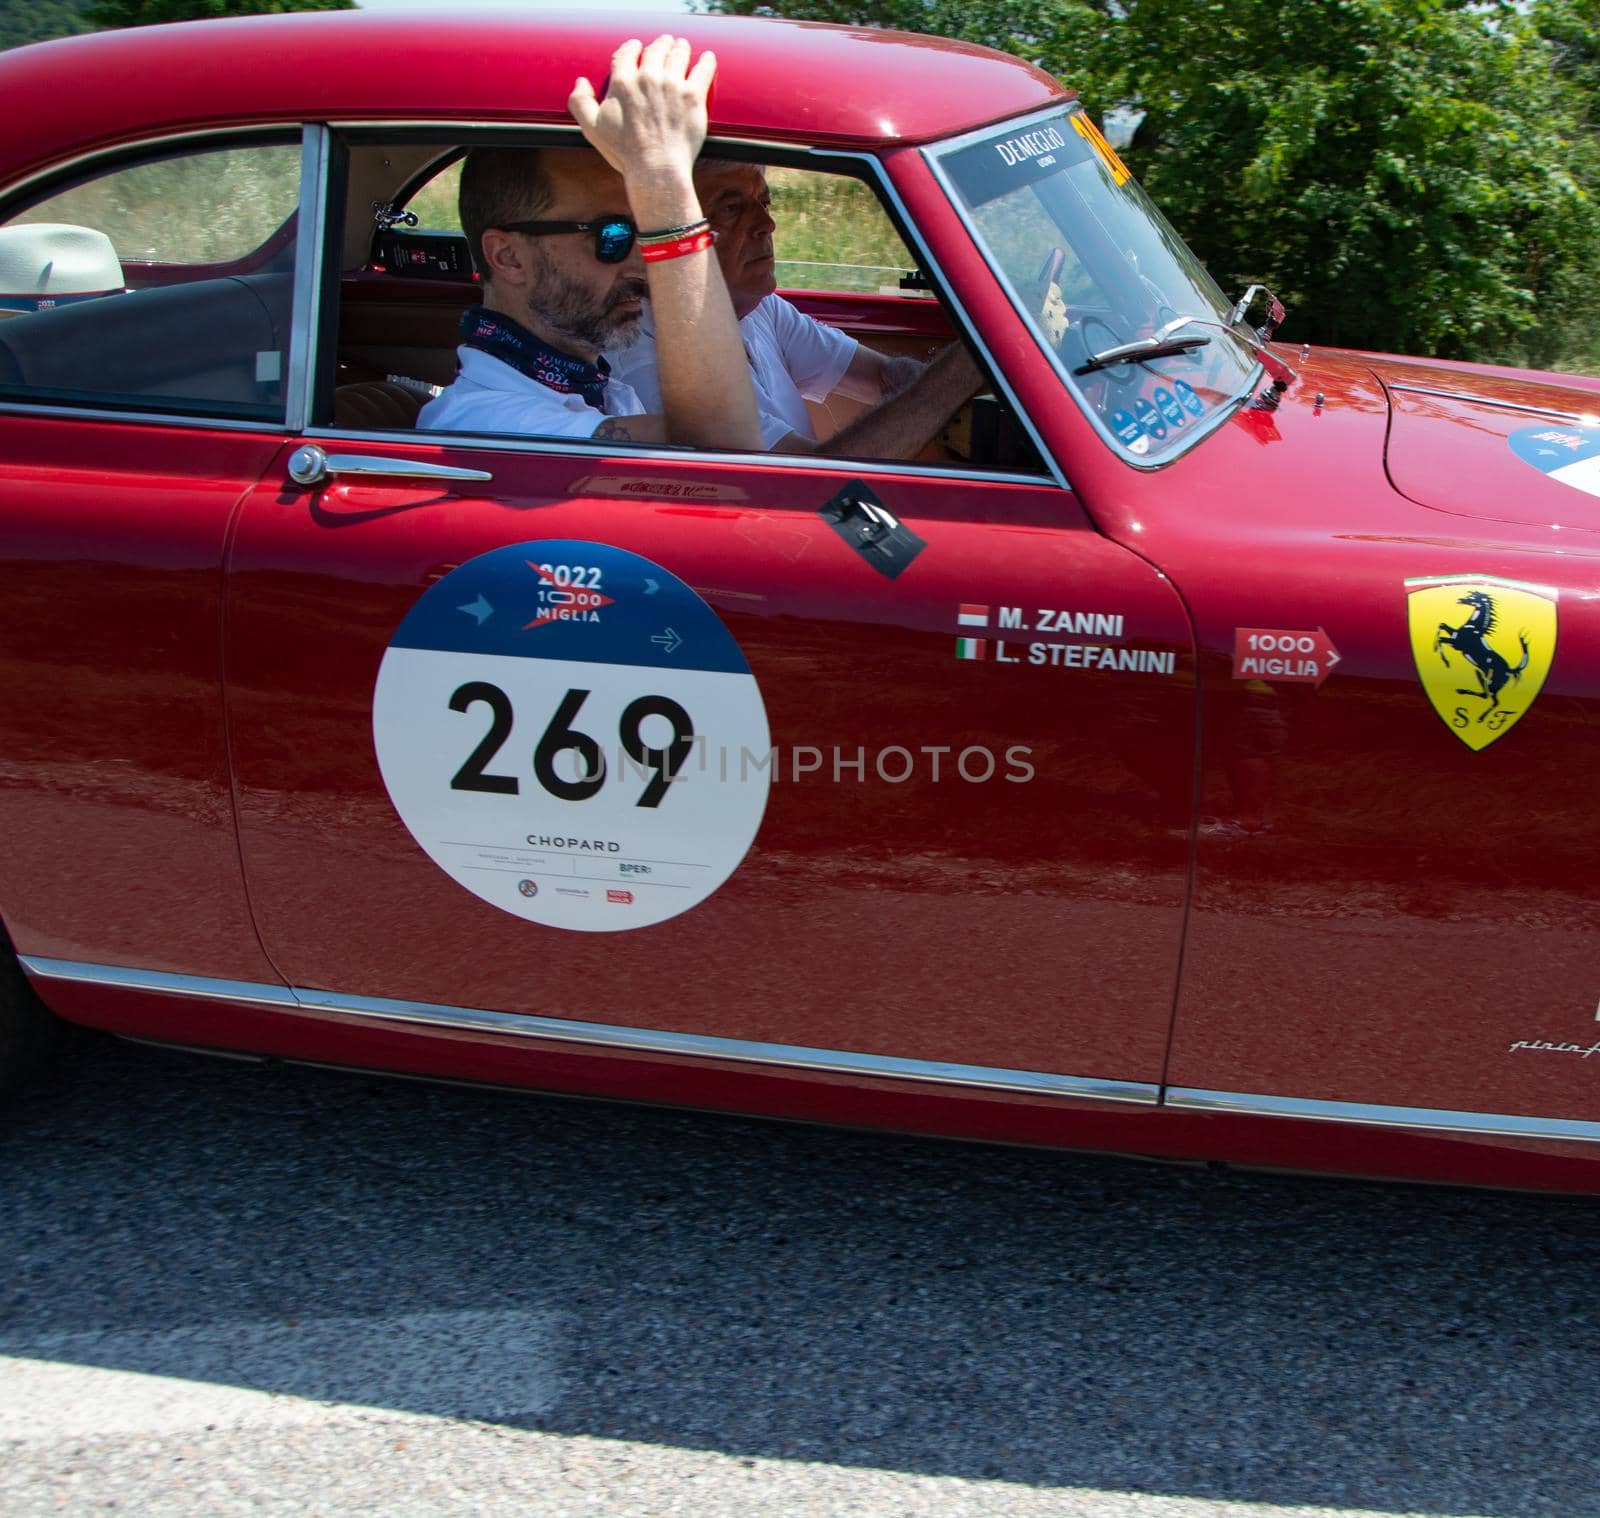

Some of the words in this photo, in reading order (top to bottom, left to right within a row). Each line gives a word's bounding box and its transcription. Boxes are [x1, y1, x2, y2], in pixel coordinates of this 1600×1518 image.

[537, 563, 602, 589] 2022
[537, 590, 602, 606] 1000
[536, 606, 600, 623] MIGLIA
[998, 606, 1029, 630] M.
[1036, 609, 1124, 636] ZANNI
[1247, 634, 1315, 654] 1000
[996, 640, 1020, 663] L.
[1028, 642, 1176, 674] STEFANINI
[1241, 657, 1319, 677] MIGLIA
[1452, 706, 1470, 729] S
[448, 681, 695, 809] 269
[526, 834, 621, 852] CHOPARD
